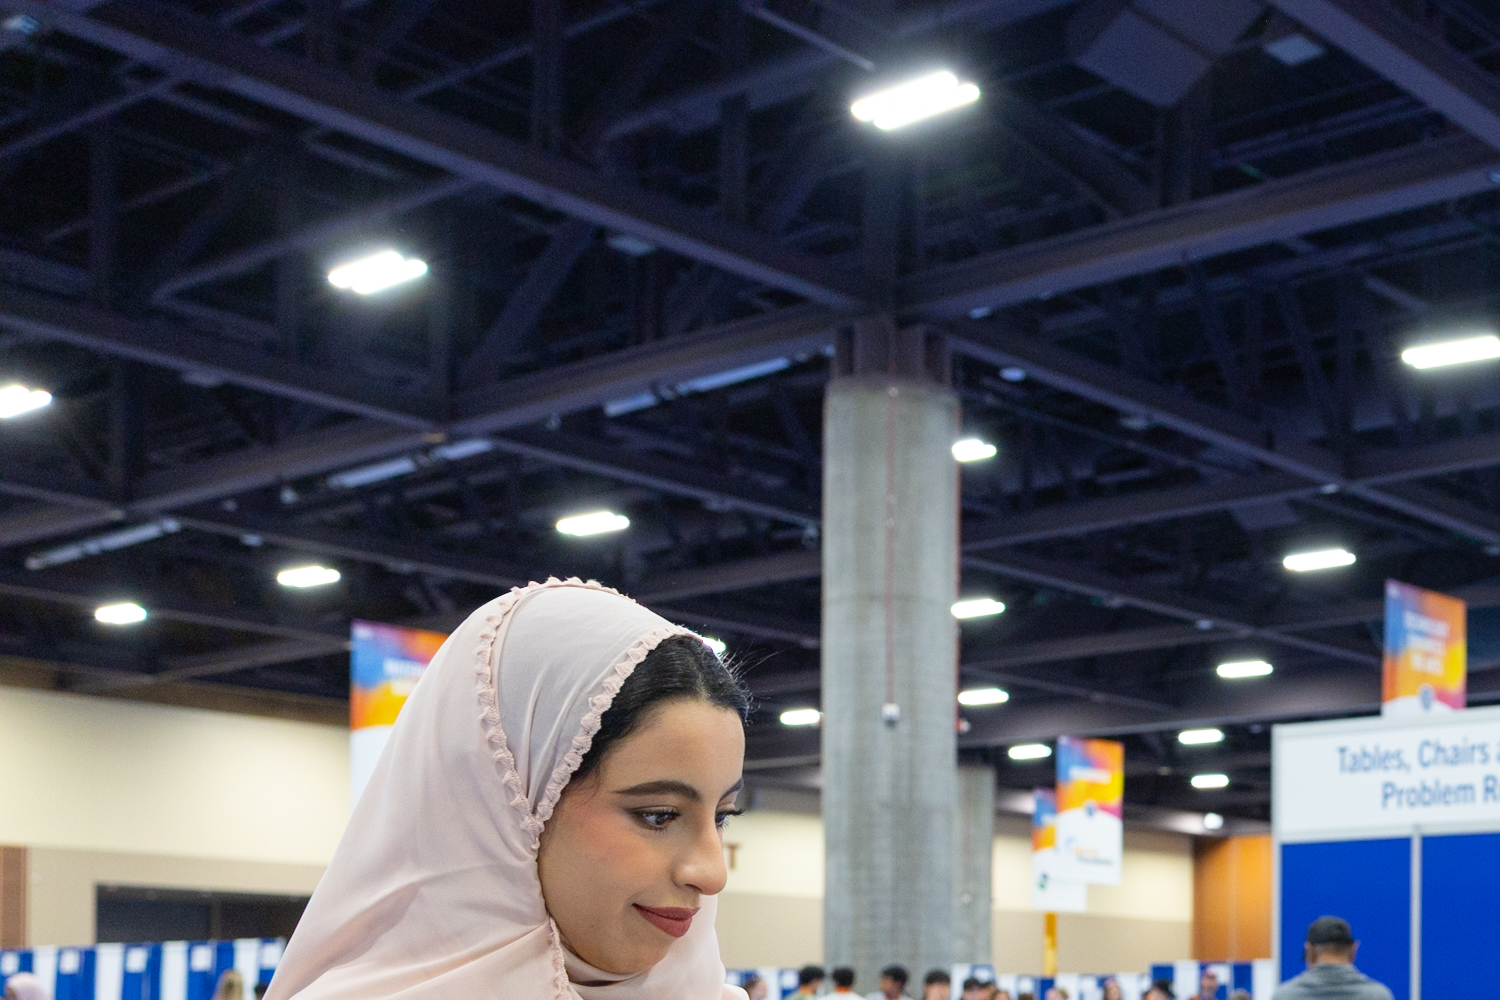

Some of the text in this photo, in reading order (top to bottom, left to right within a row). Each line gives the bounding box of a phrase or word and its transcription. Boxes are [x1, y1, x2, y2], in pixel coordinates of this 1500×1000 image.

[1337, 745, 1412, 774] Tables,
[1417, 737, 1490, 767] Chairs
[1381, 777, 1477, 809] Problem
